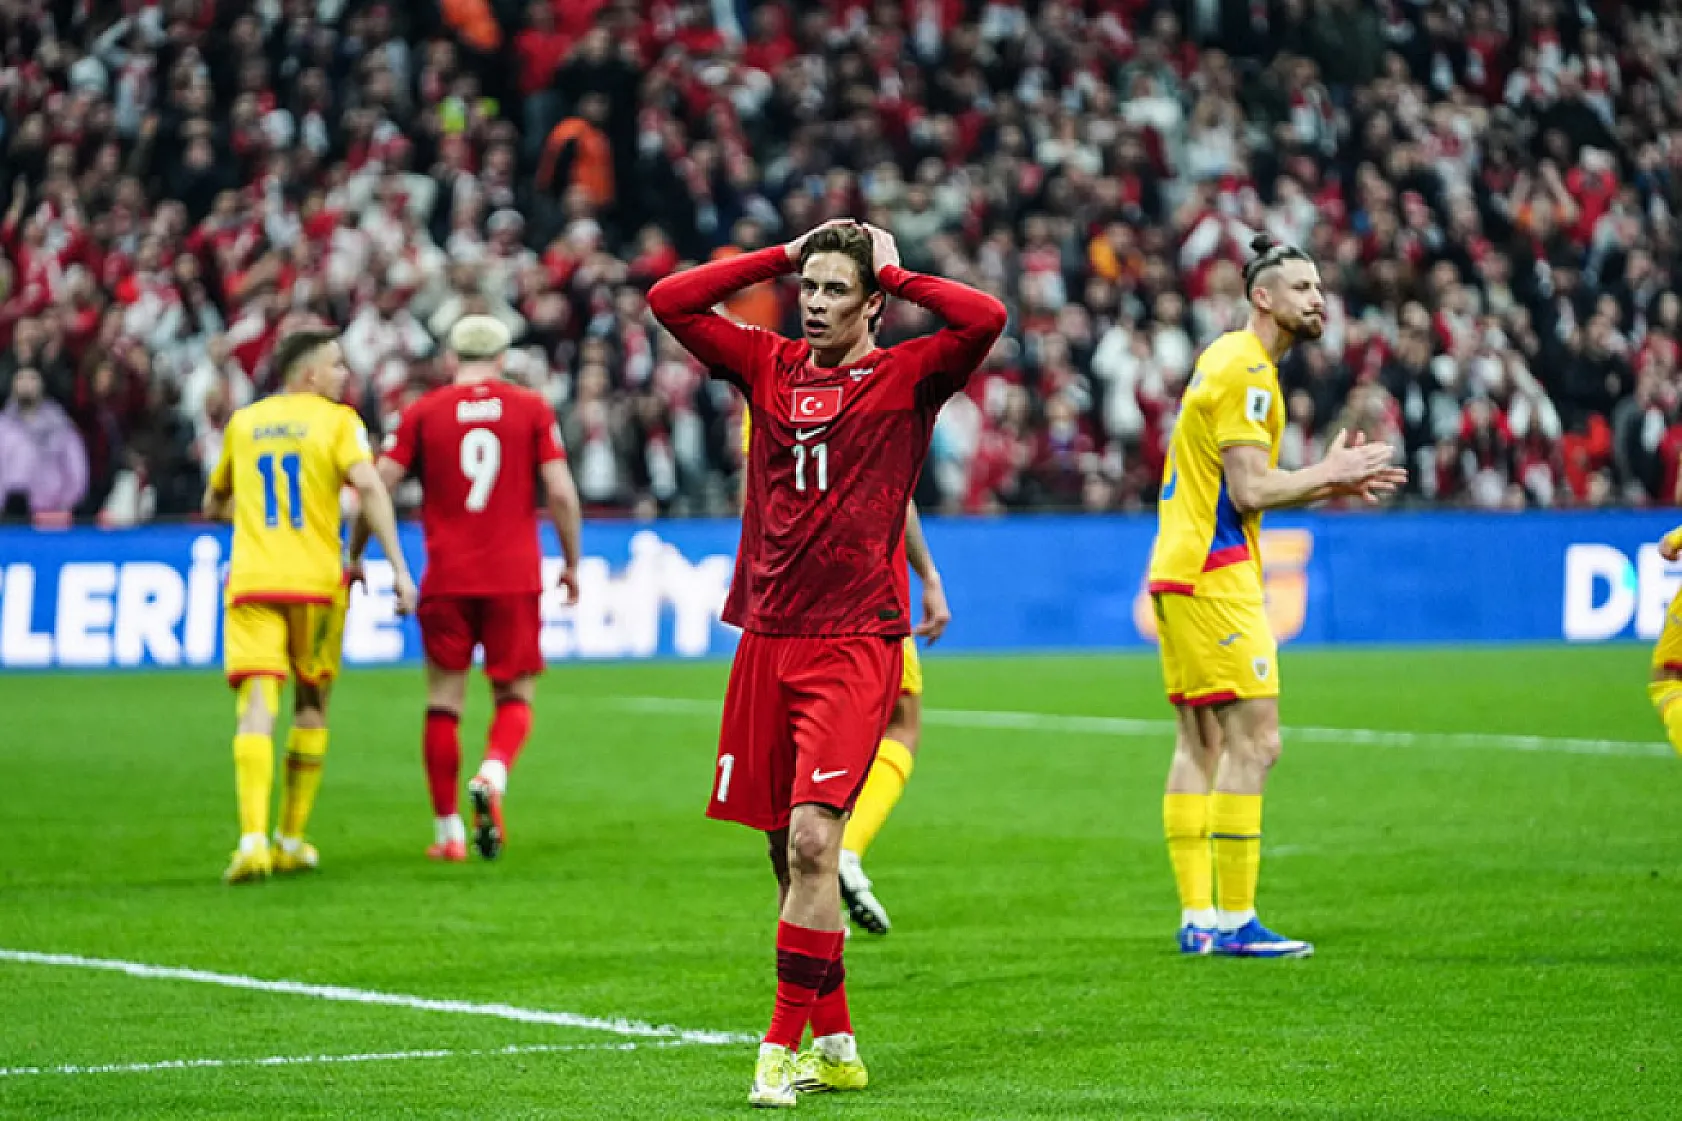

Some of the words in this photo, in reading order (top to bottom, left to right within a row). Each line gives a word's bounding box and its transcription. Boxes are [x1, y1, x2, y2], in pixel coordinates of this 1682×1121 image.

[256, 453, 304, 528] 11
[460, 427, 502, 512] 9
[791, 443, 828, 492] 11
[0, 534, 221, 668] LERİ
